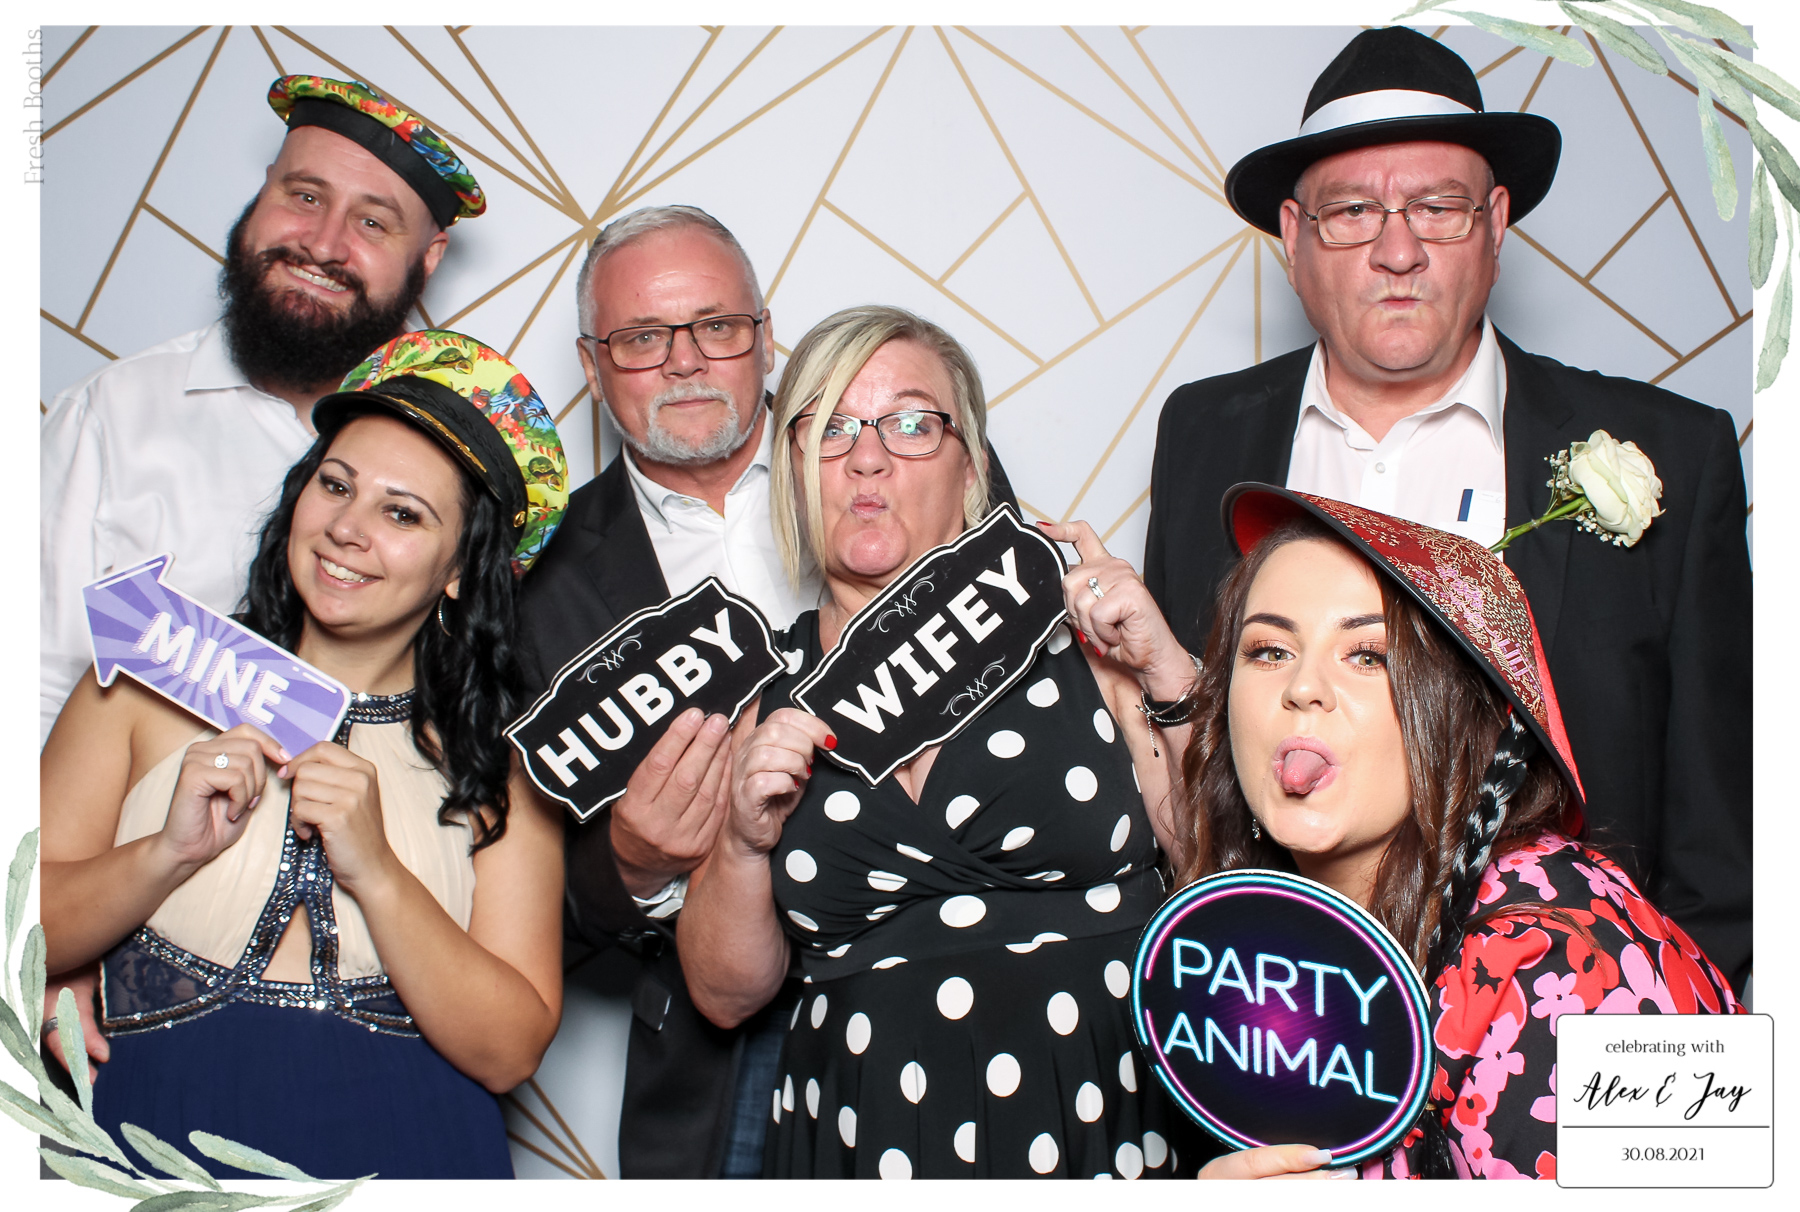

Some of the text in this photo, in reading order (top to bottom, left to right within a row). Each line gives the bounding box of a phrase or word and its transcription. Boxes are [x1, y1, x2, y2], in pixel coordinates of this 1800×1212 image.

[131, 611, 290, 726] MINE
[536, 607, 744, 788] HUBBY
[832, 546, 1031, 734] WIFEY
[1173, 937, 1388, 1025] PARTY
[1163, 1012, 1399, 1103] ANIMAL
